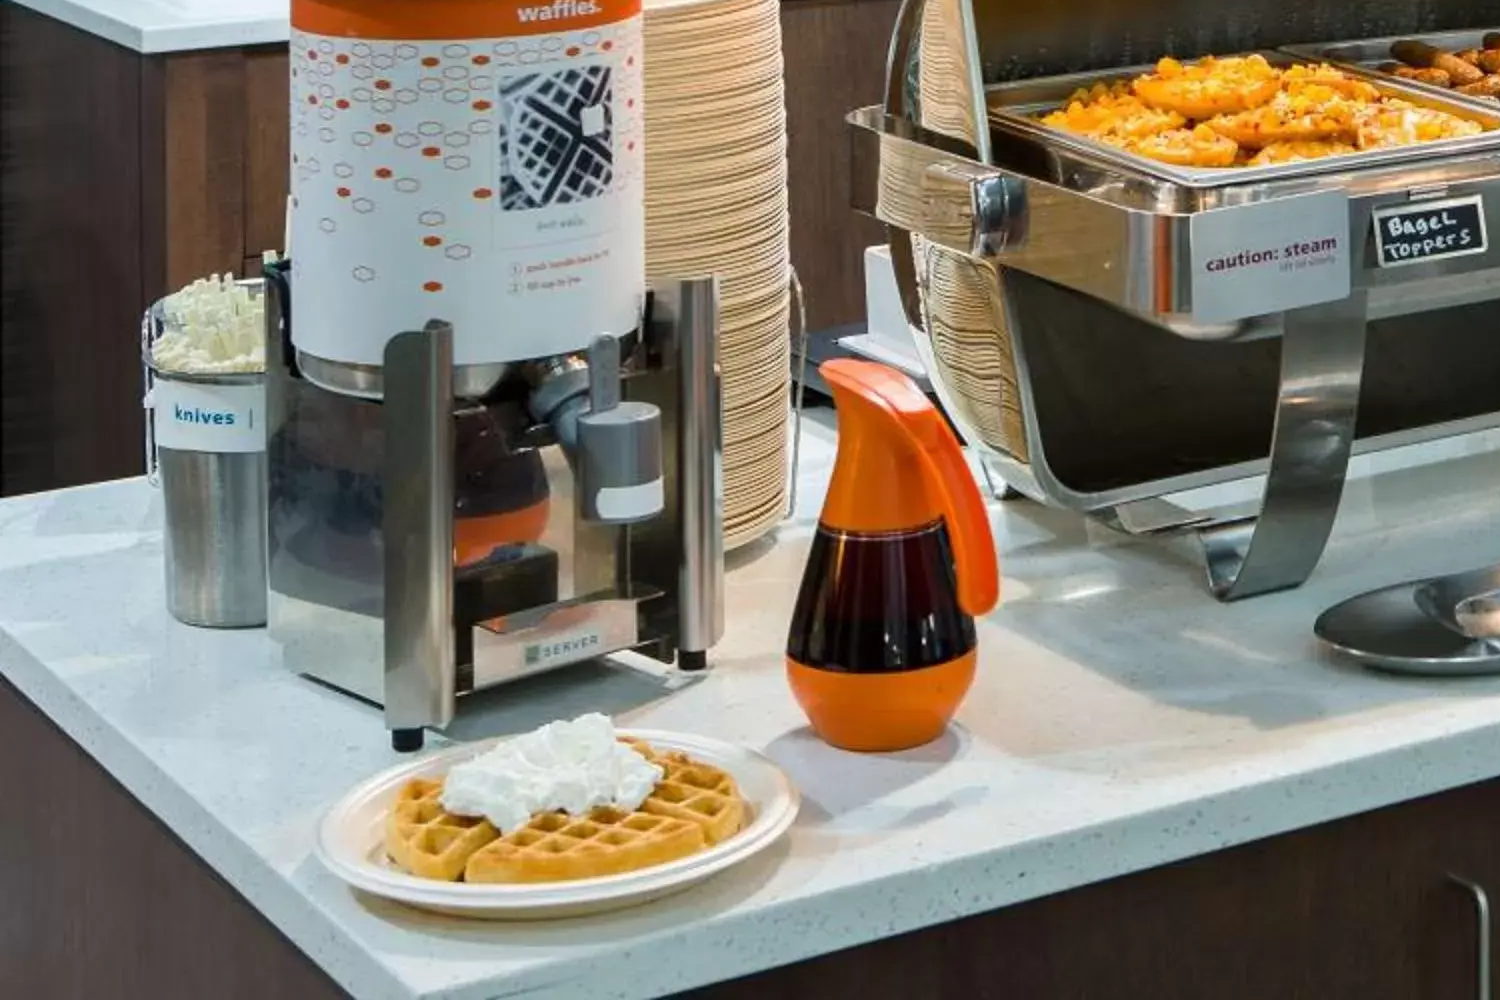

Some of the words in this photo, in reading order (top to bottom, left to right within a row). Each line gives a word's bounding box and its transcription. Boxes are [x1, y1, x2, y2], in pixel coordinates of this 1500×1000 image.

[1205, 247, 1279, 273] caution:
[1284, 235, 1337, 258] steam
[174, 402, 235, 425] knives
